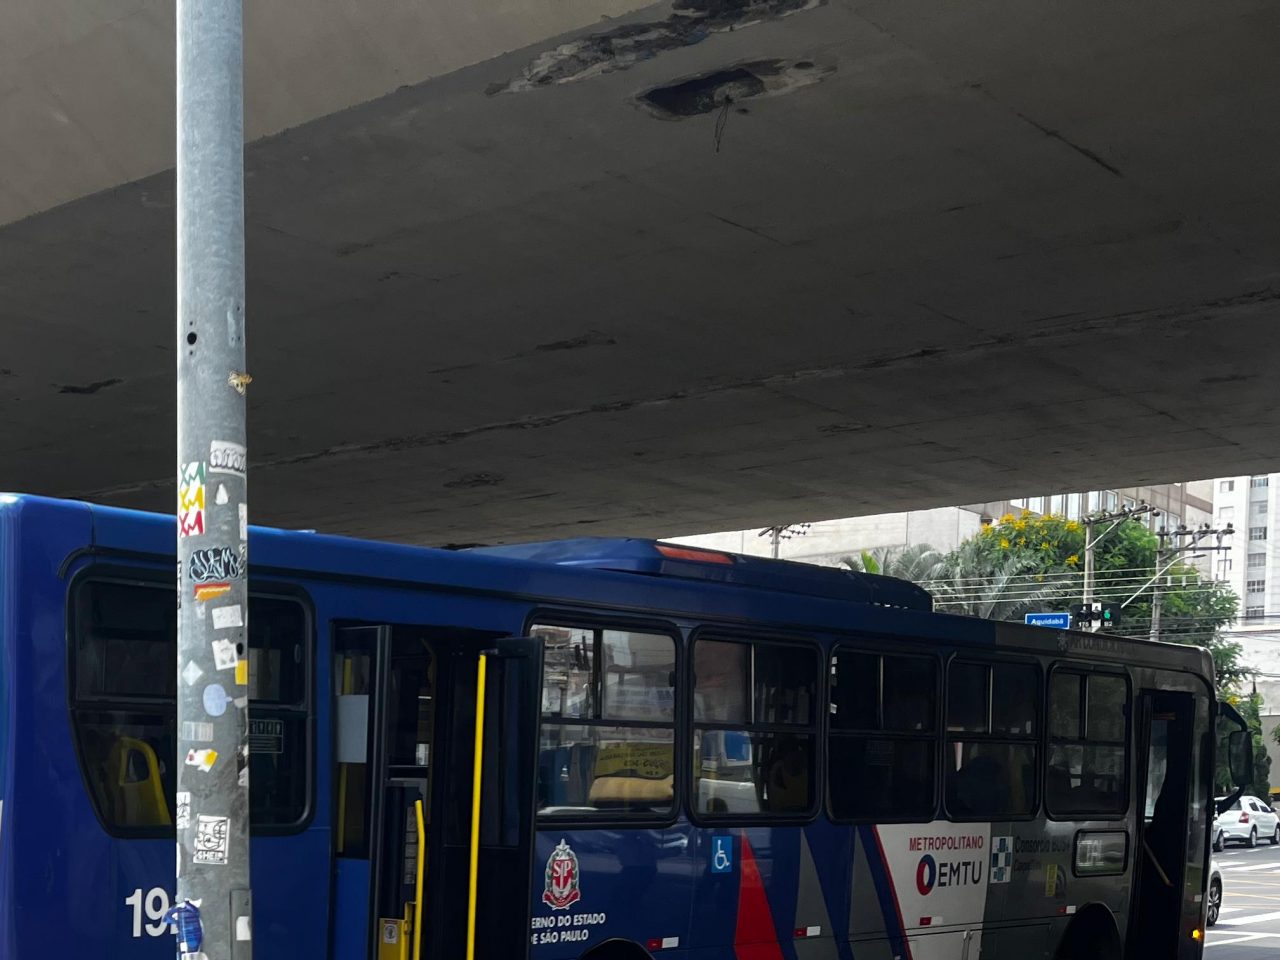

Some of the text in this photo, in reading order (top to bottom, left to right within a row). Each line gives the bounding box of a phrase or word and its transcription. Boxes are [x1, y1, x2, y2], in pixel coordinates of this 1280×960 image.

[909, 835, 984, 851] METROPOLITANO
[938, 860, 982, 887] EMTU
[531, 912, 606, 929] ERNO DO ESTADO
[531, 929, 589, 945] E SÃO PAULO
